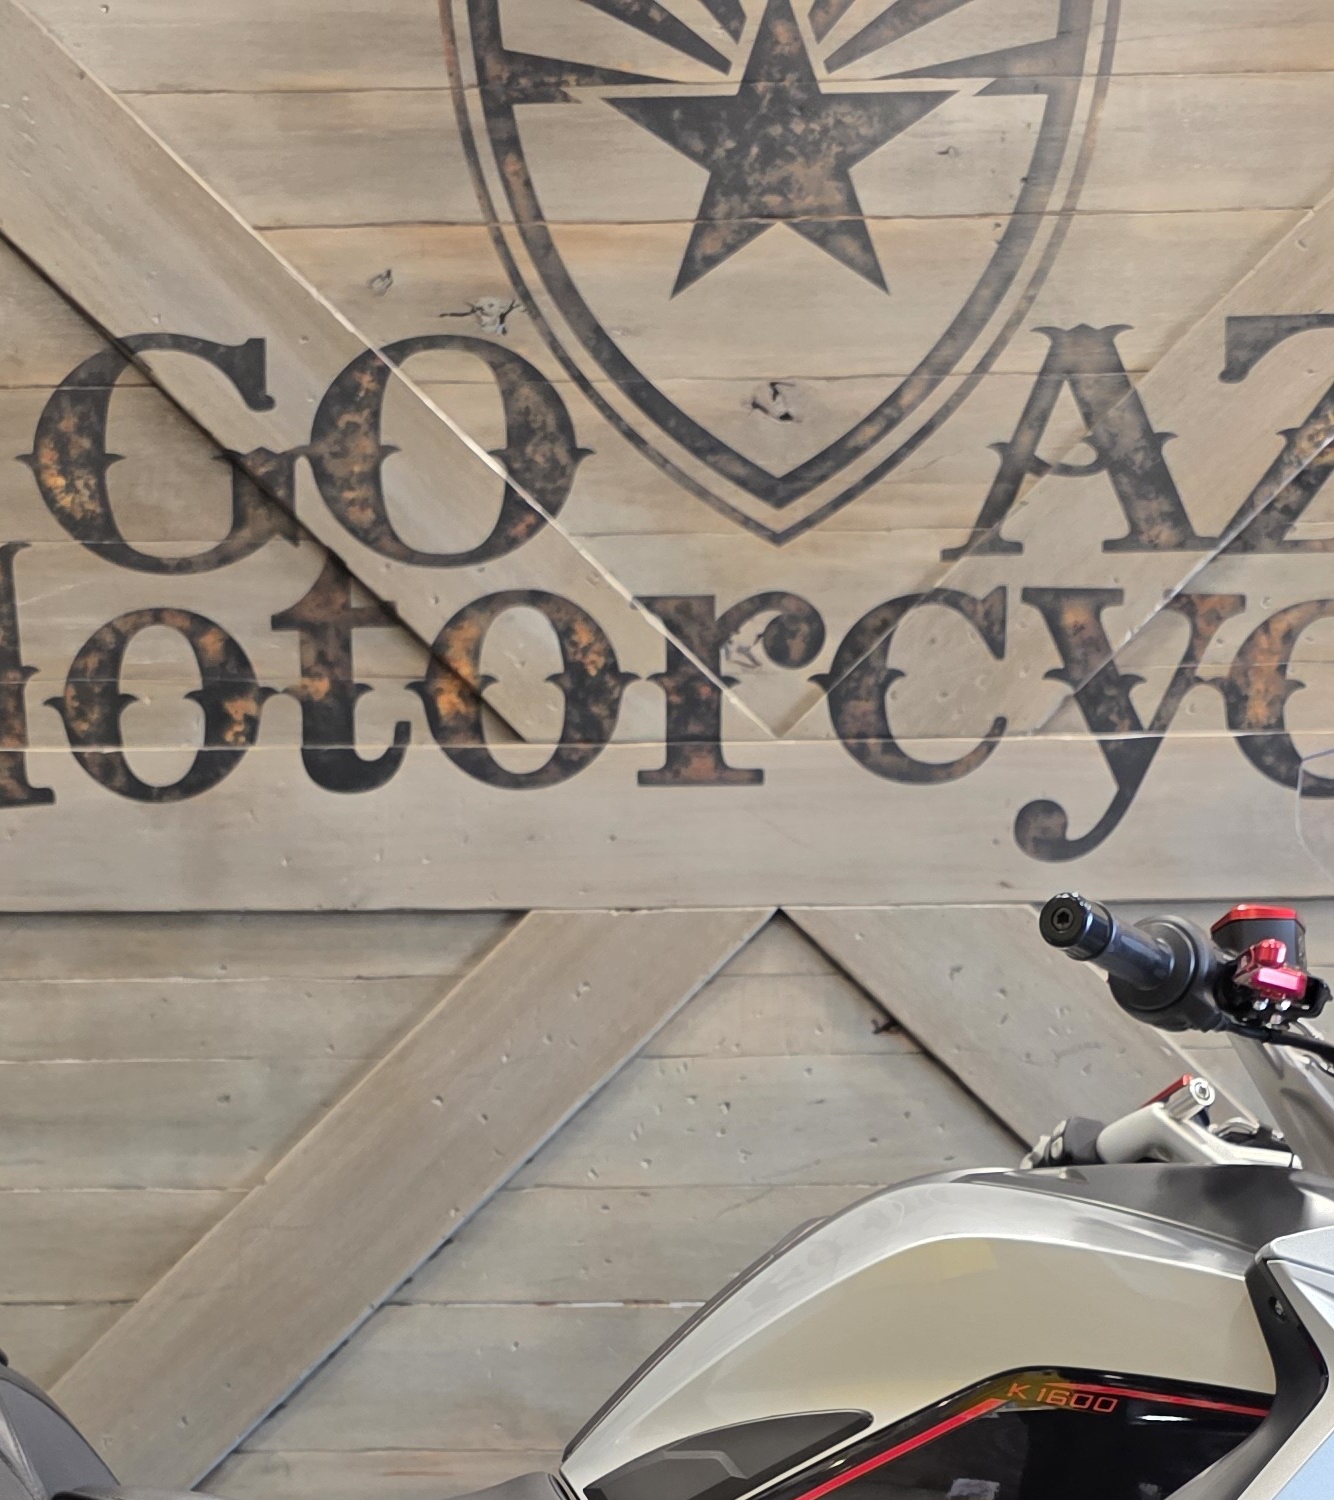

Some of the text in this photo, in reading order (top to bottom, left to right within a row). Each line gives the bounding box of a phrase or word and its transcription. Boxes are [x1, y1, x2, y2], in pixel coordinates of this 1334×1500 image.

[15, 332, 596, 576] GO
[1007, 1382, 1118, 1413] K 1600
